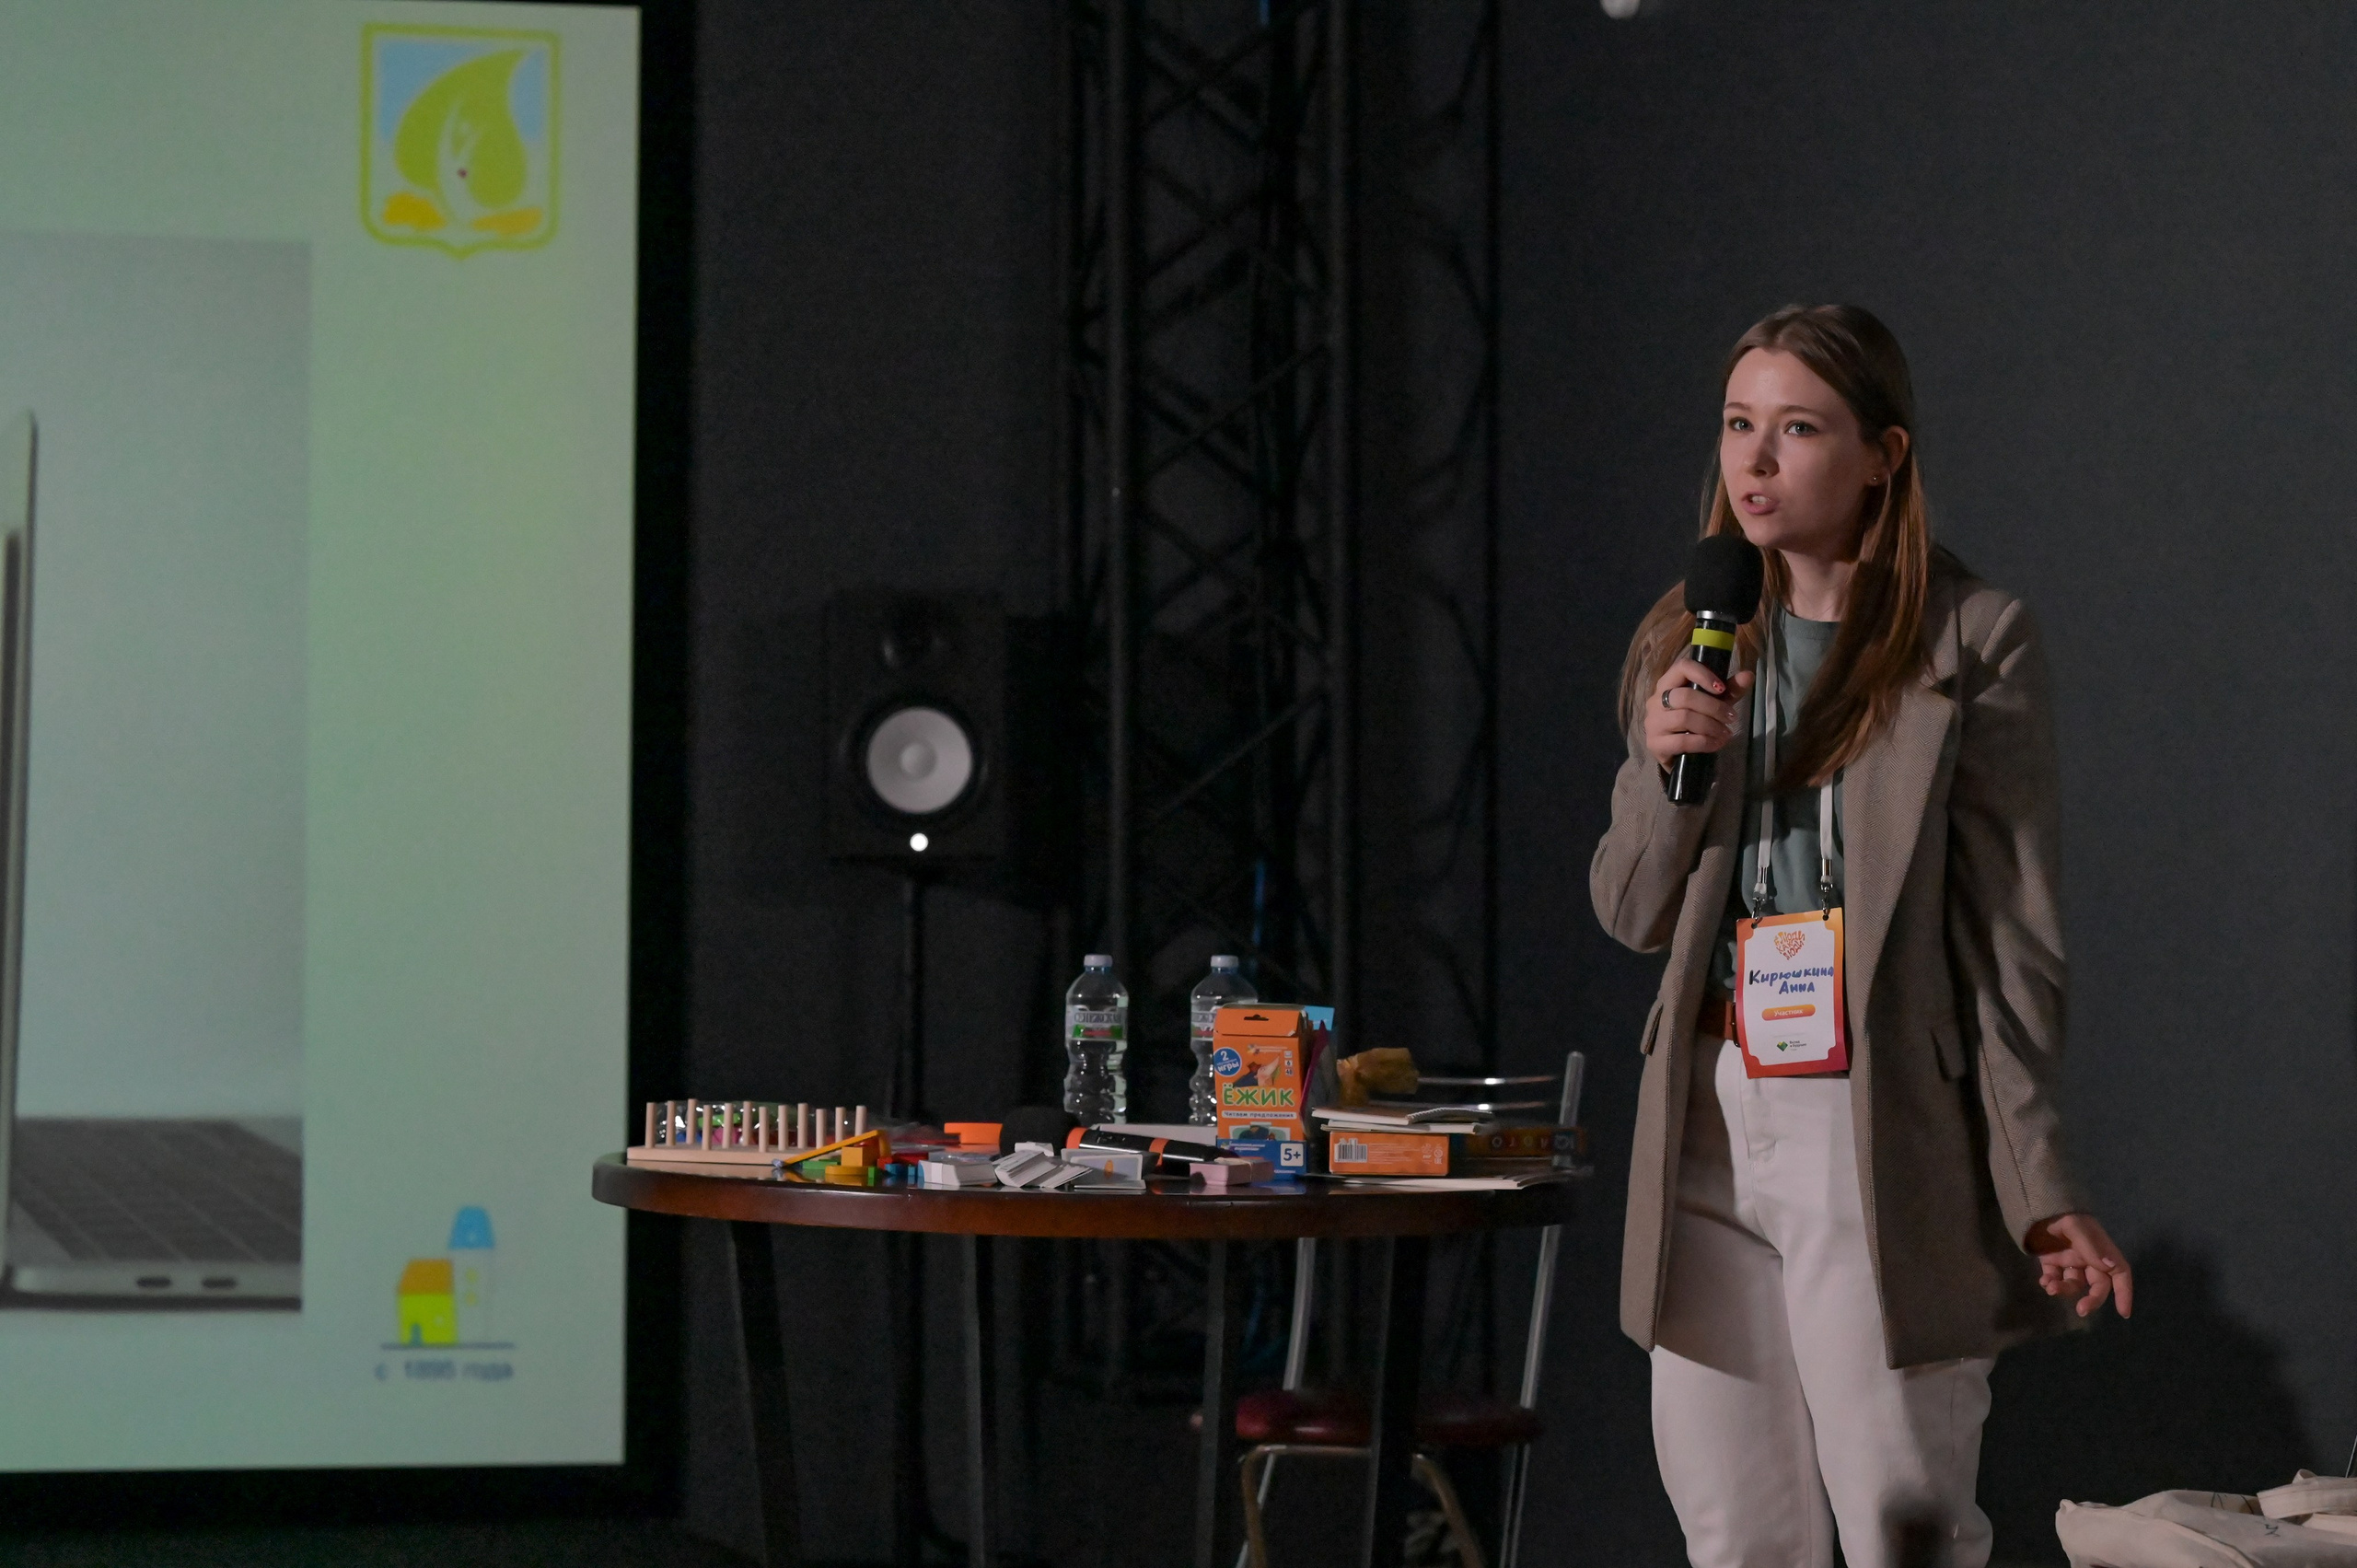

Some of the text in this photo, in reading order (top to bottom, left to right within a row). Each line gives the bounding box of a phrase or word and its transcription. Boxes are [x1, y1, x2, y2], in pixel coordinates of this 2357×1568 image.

[1749, 966, 1834, 987] Кирюшкина
[1779, 981, 1816, 994] Анна
[1773, 1008, 1804, 1017] Участник
[1220, 1051, 1229, 1062] 2
[1218, 1061, 1239, 1072] игры
[1223, 1084, 1295, 1106] ЁЖИК
[1283, 1148, 1301, 1161] 5+
